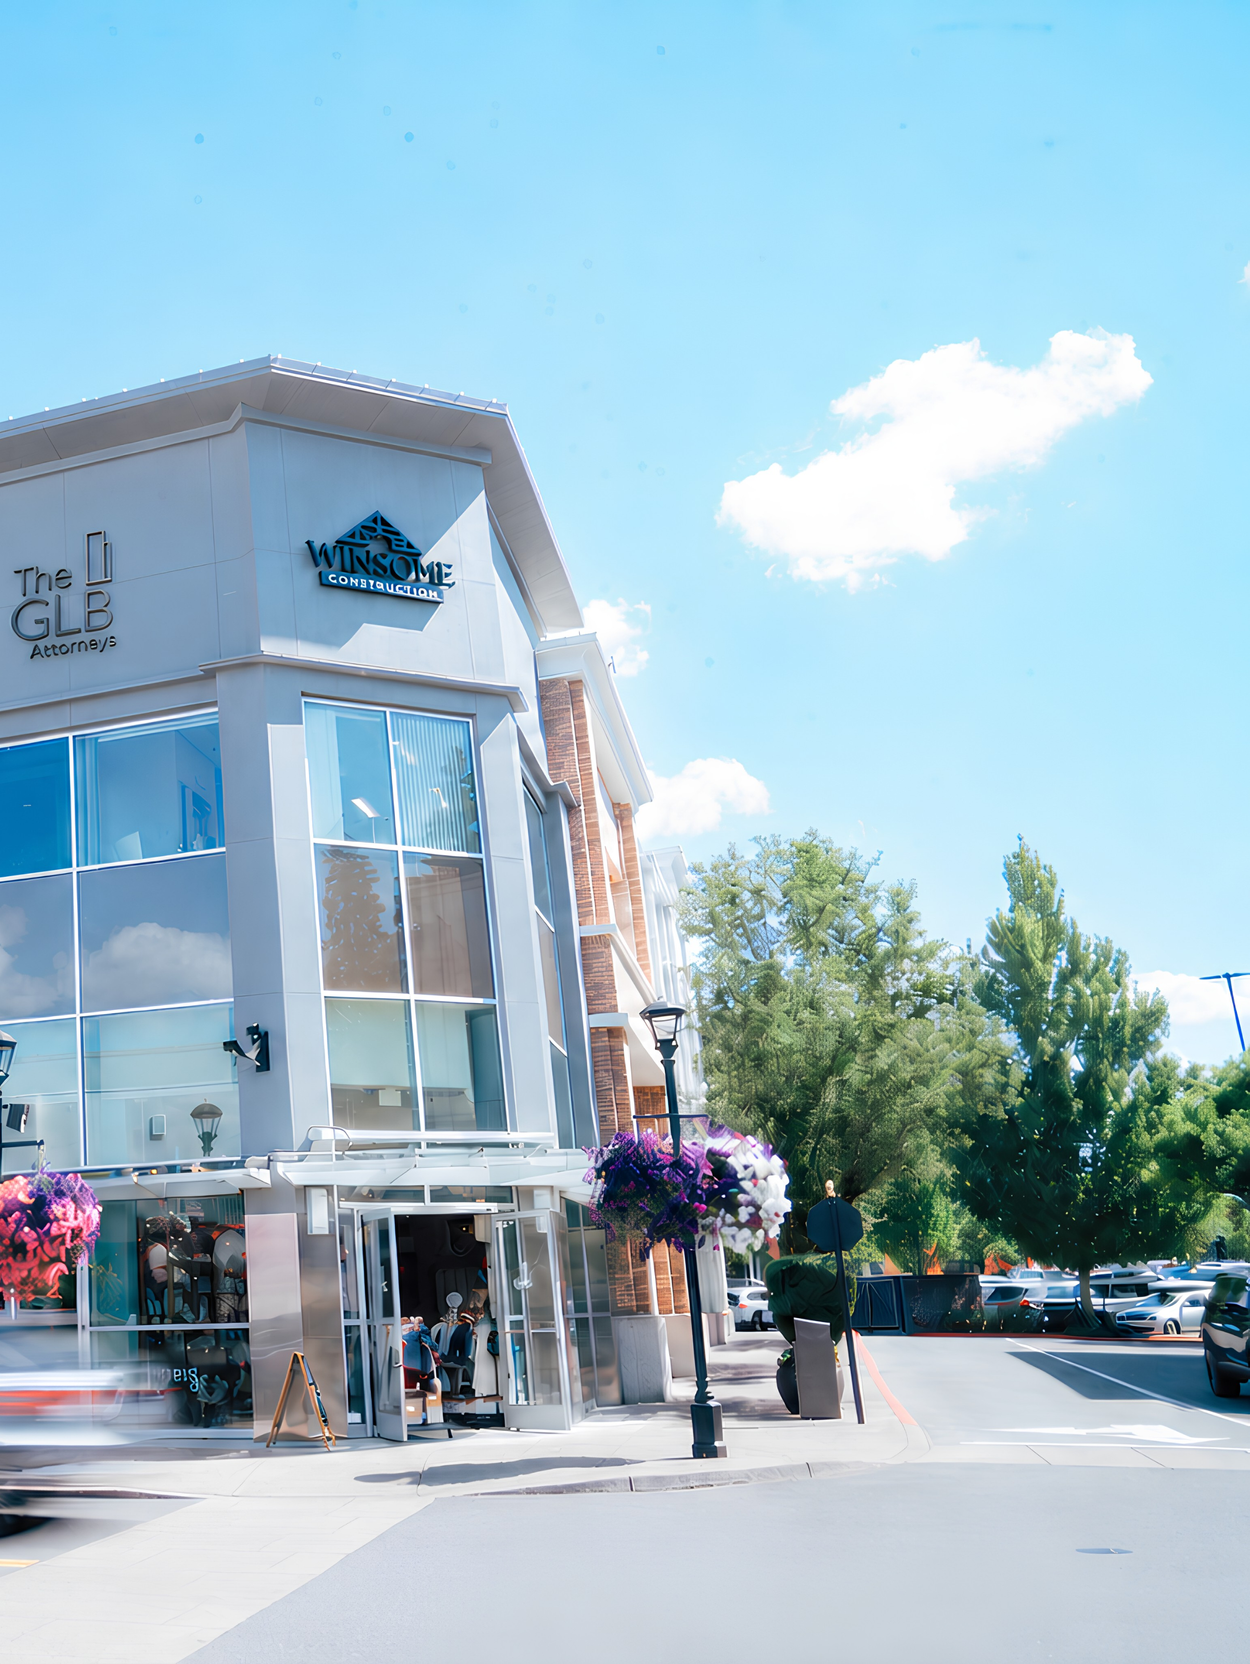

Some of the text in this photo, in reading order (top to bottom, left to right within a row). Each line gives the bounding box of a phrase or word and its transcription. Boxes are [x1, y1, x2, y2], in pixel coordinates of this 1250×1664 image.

[305, 540, 455, 589] WINSOME
[14, 566, 72, 597] The
[328, 574, 438, 598] CONSTRUCTION
[11, 589, 113, 641] GLB
[30, 636, 116, 659] Attorneys
